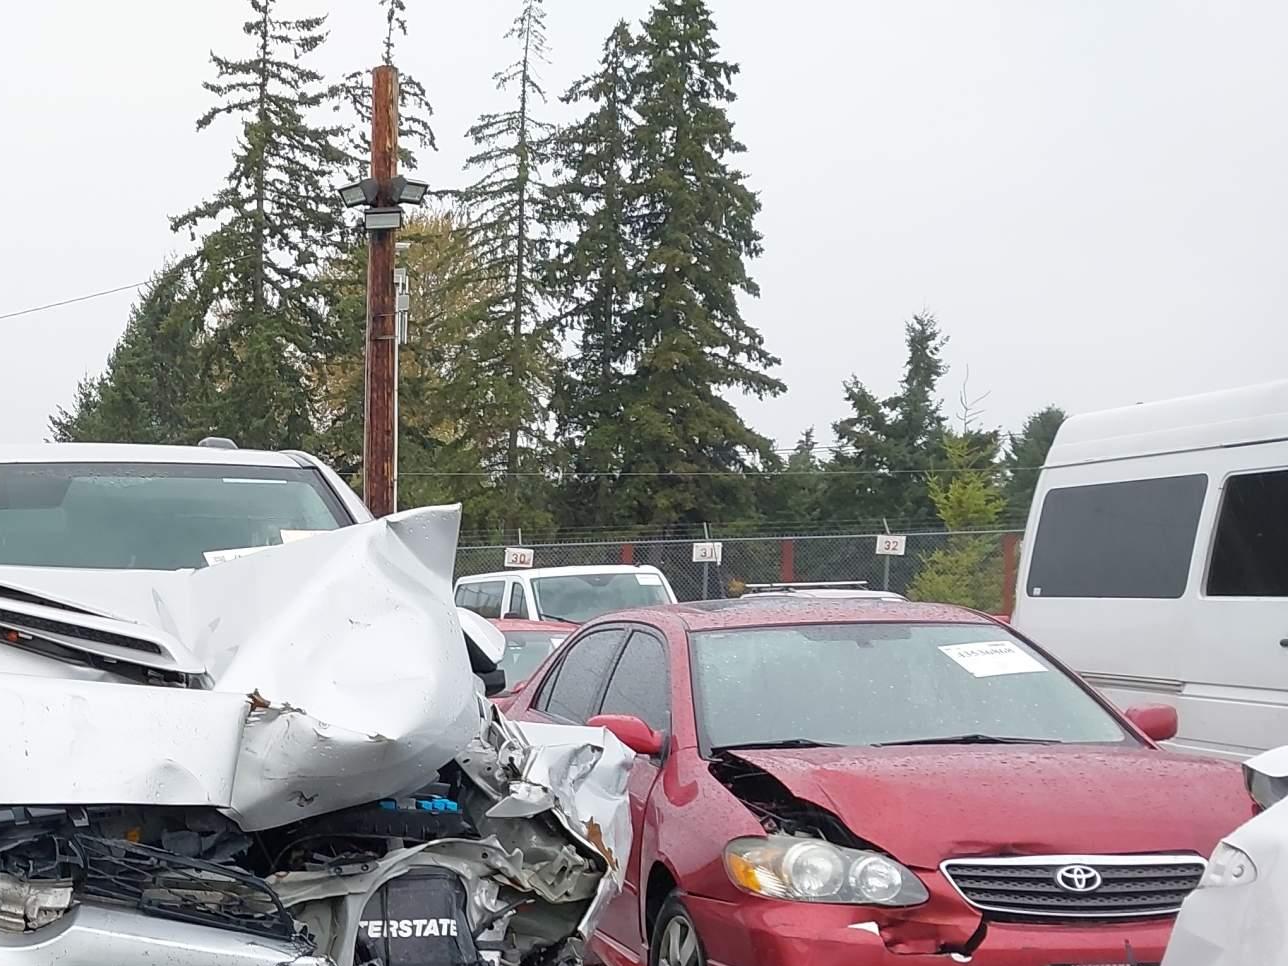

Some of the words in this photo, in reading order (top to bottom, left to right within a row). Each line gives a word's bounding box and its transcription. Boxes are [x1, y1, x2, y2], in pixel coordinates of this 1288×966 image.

[884, 541, 898, 551] 32
[700, 548, 713, 558] 31
[511, 553, 526, 564] 30
